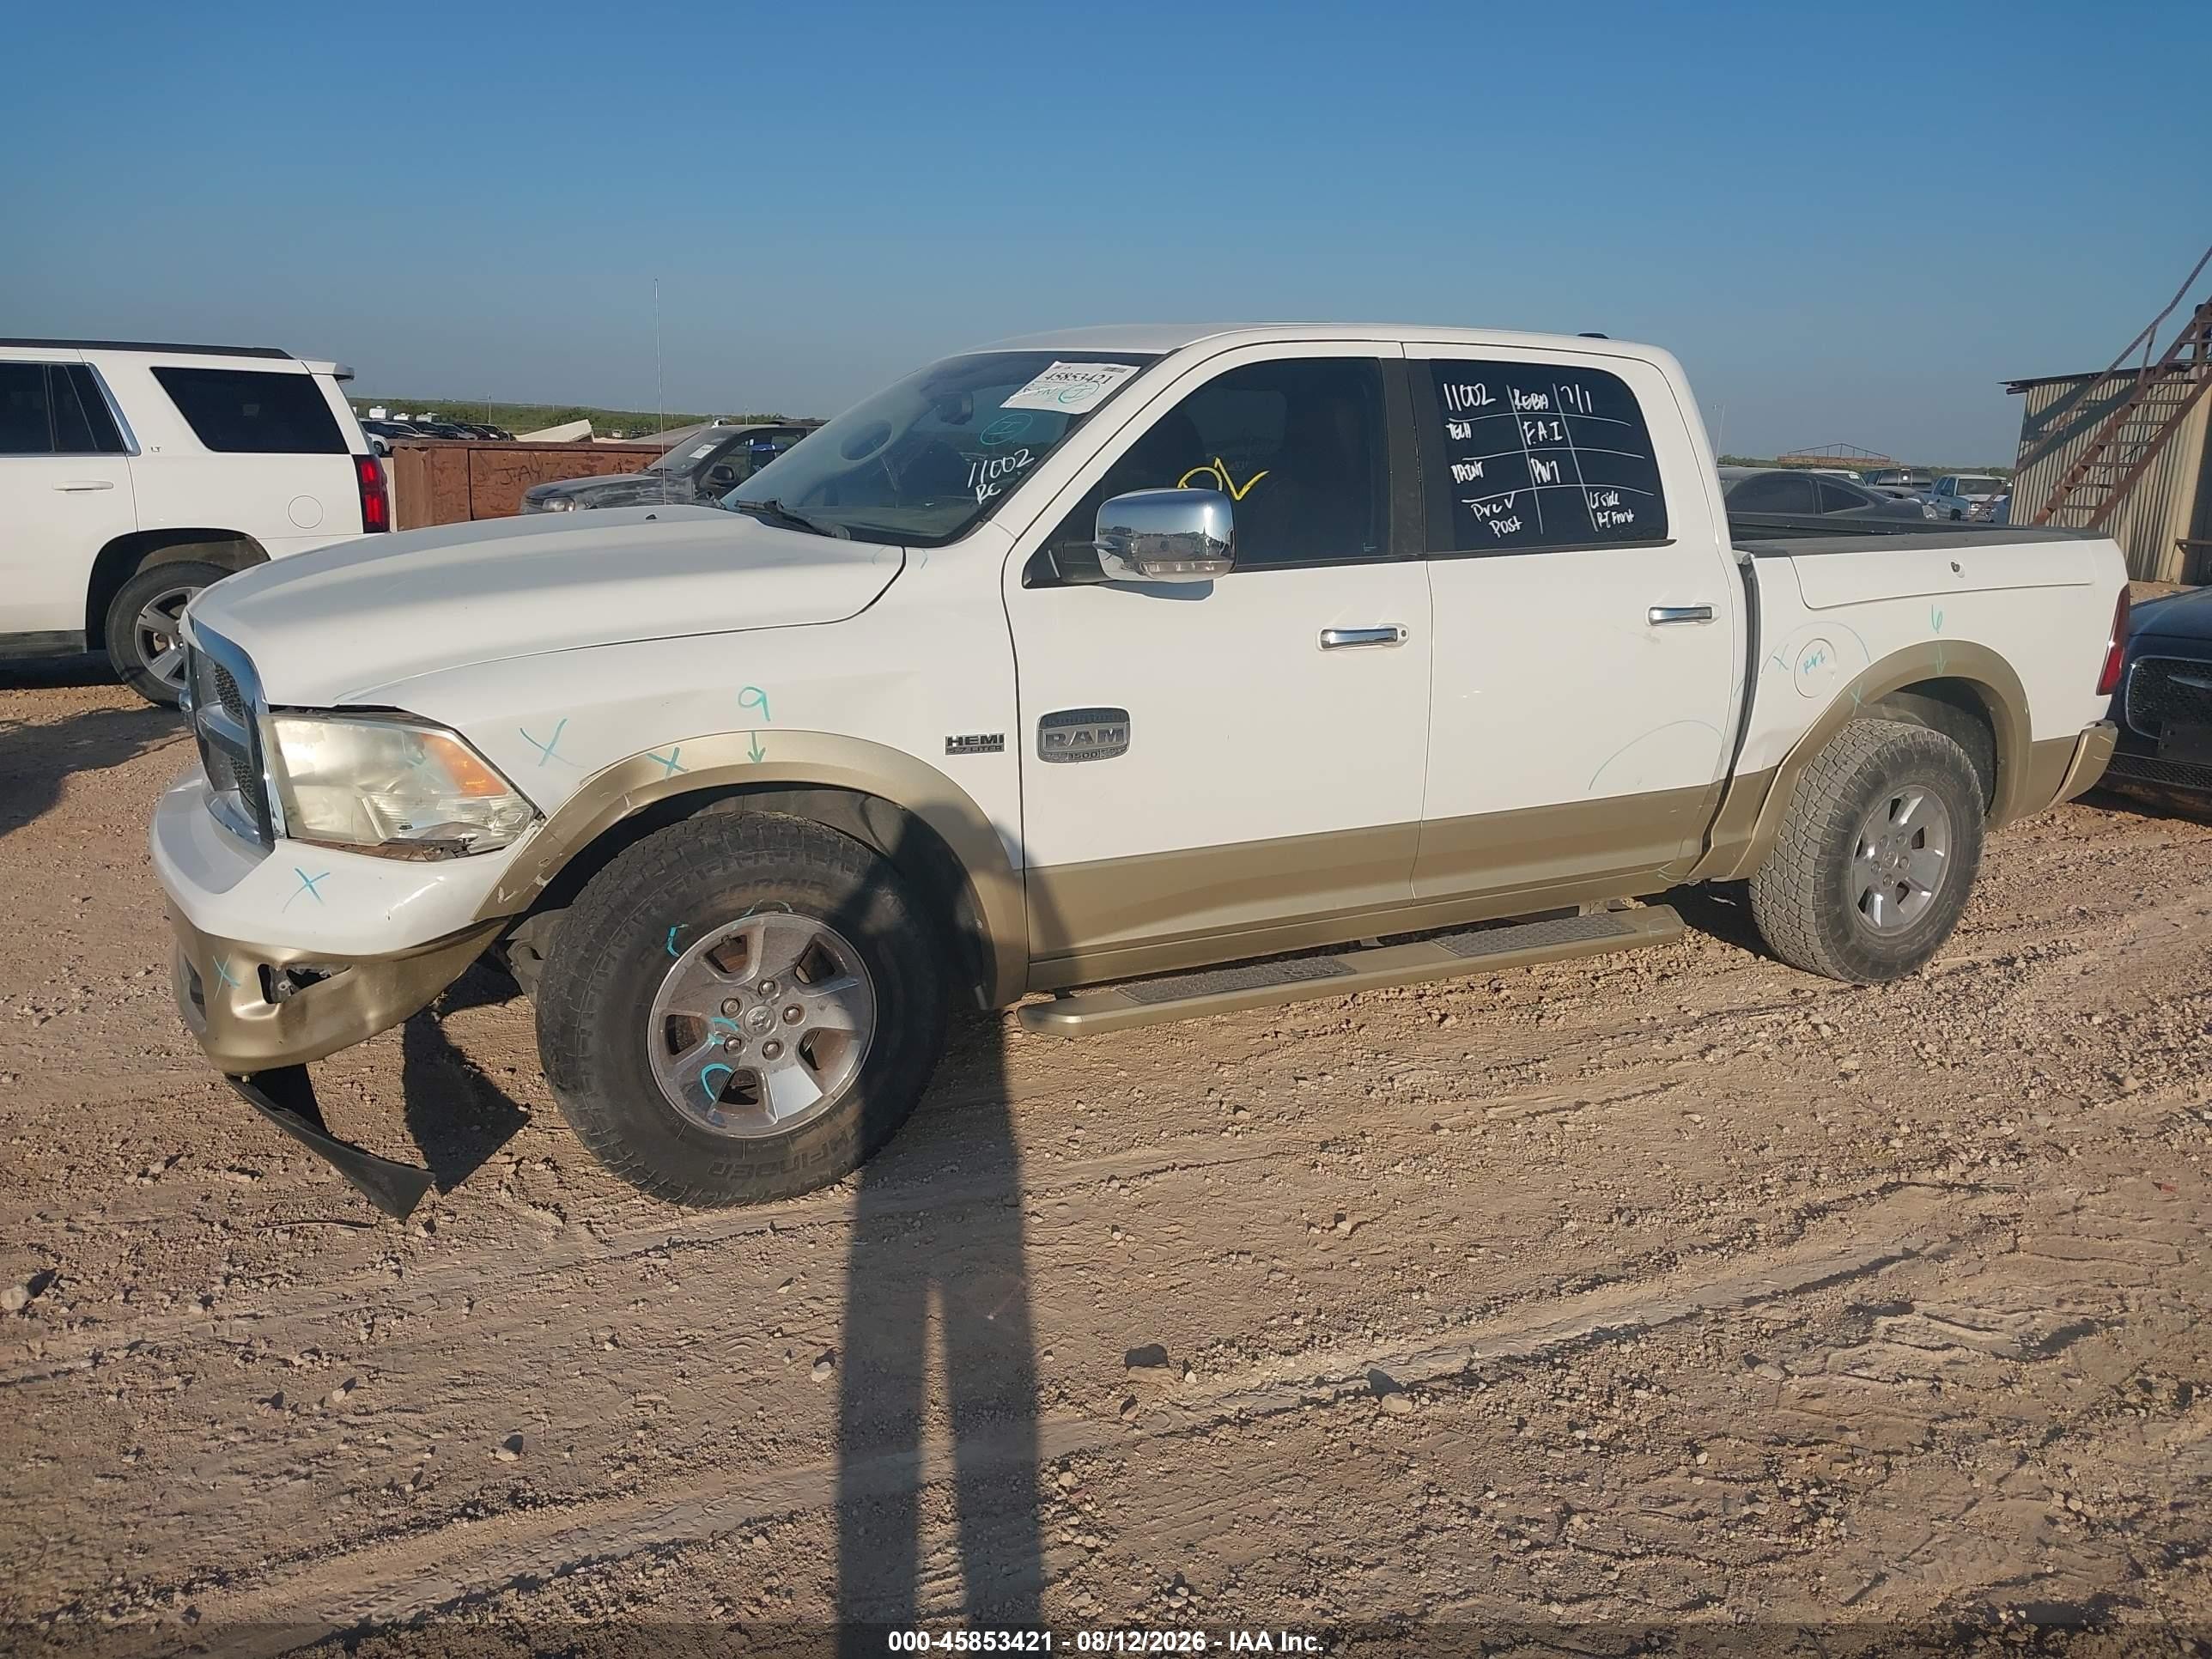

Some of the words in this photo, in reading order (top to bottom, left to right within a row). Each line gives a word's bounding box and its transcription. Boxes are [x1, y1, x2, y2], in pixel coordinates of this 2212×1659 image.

[1045, 372, 1115, 385] 45853421
[1443, 383, 1497, 411] 11002
[967, 448, 1036, 489] 11002
[947, 735, 1005, 746] HEMI
[1044, 727, 1125, 750] RAM
[969, 744, 1003, 753] LITER
[1071, 751, 1098, 761] 1500
